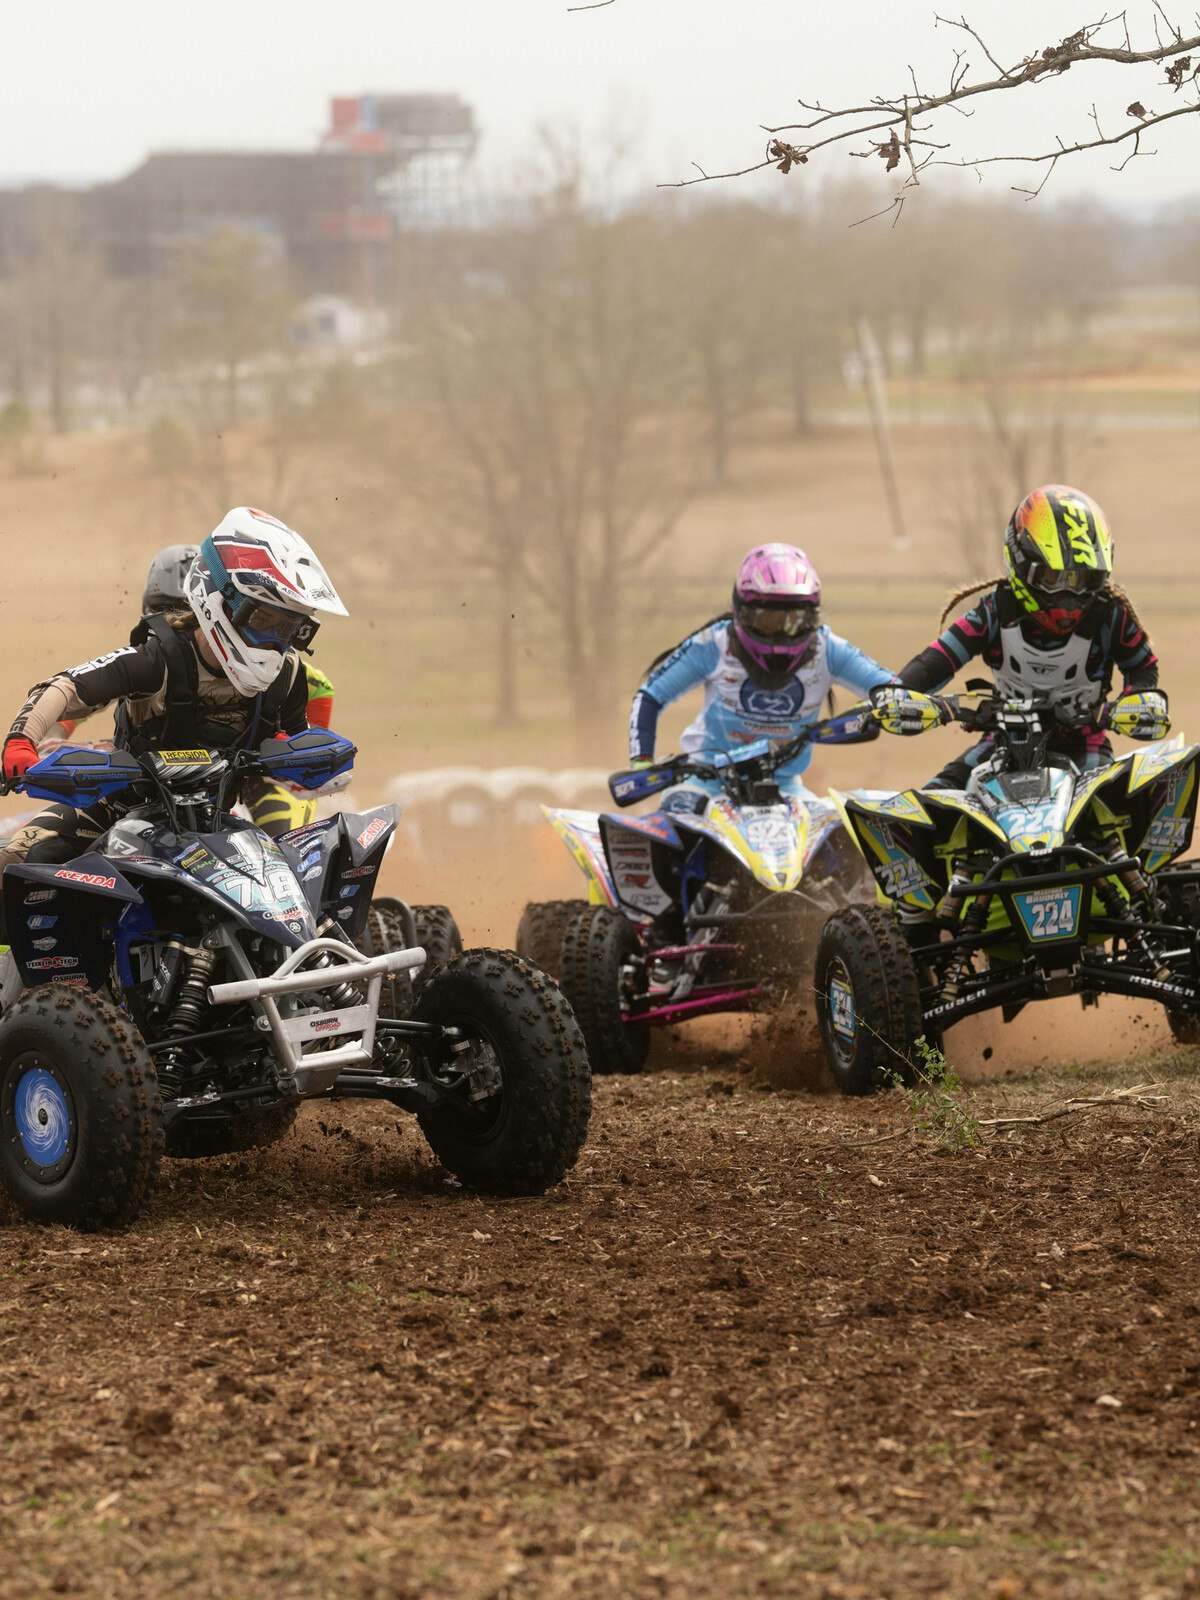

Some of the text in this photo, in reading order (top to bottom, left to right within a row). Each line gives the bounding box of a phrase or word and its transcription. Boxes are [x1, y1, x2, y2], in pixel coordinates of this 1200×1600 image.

[1058, 498, 1098, 569] FXR
[357, 818, 387, 850] KENDA
[1007, 810, 1057, 839] 224
[54, 869, 117, 890] KENDA
[1031, 899, 1074, 937] 224
[310, 1017, 339, 1028] OSBURN
